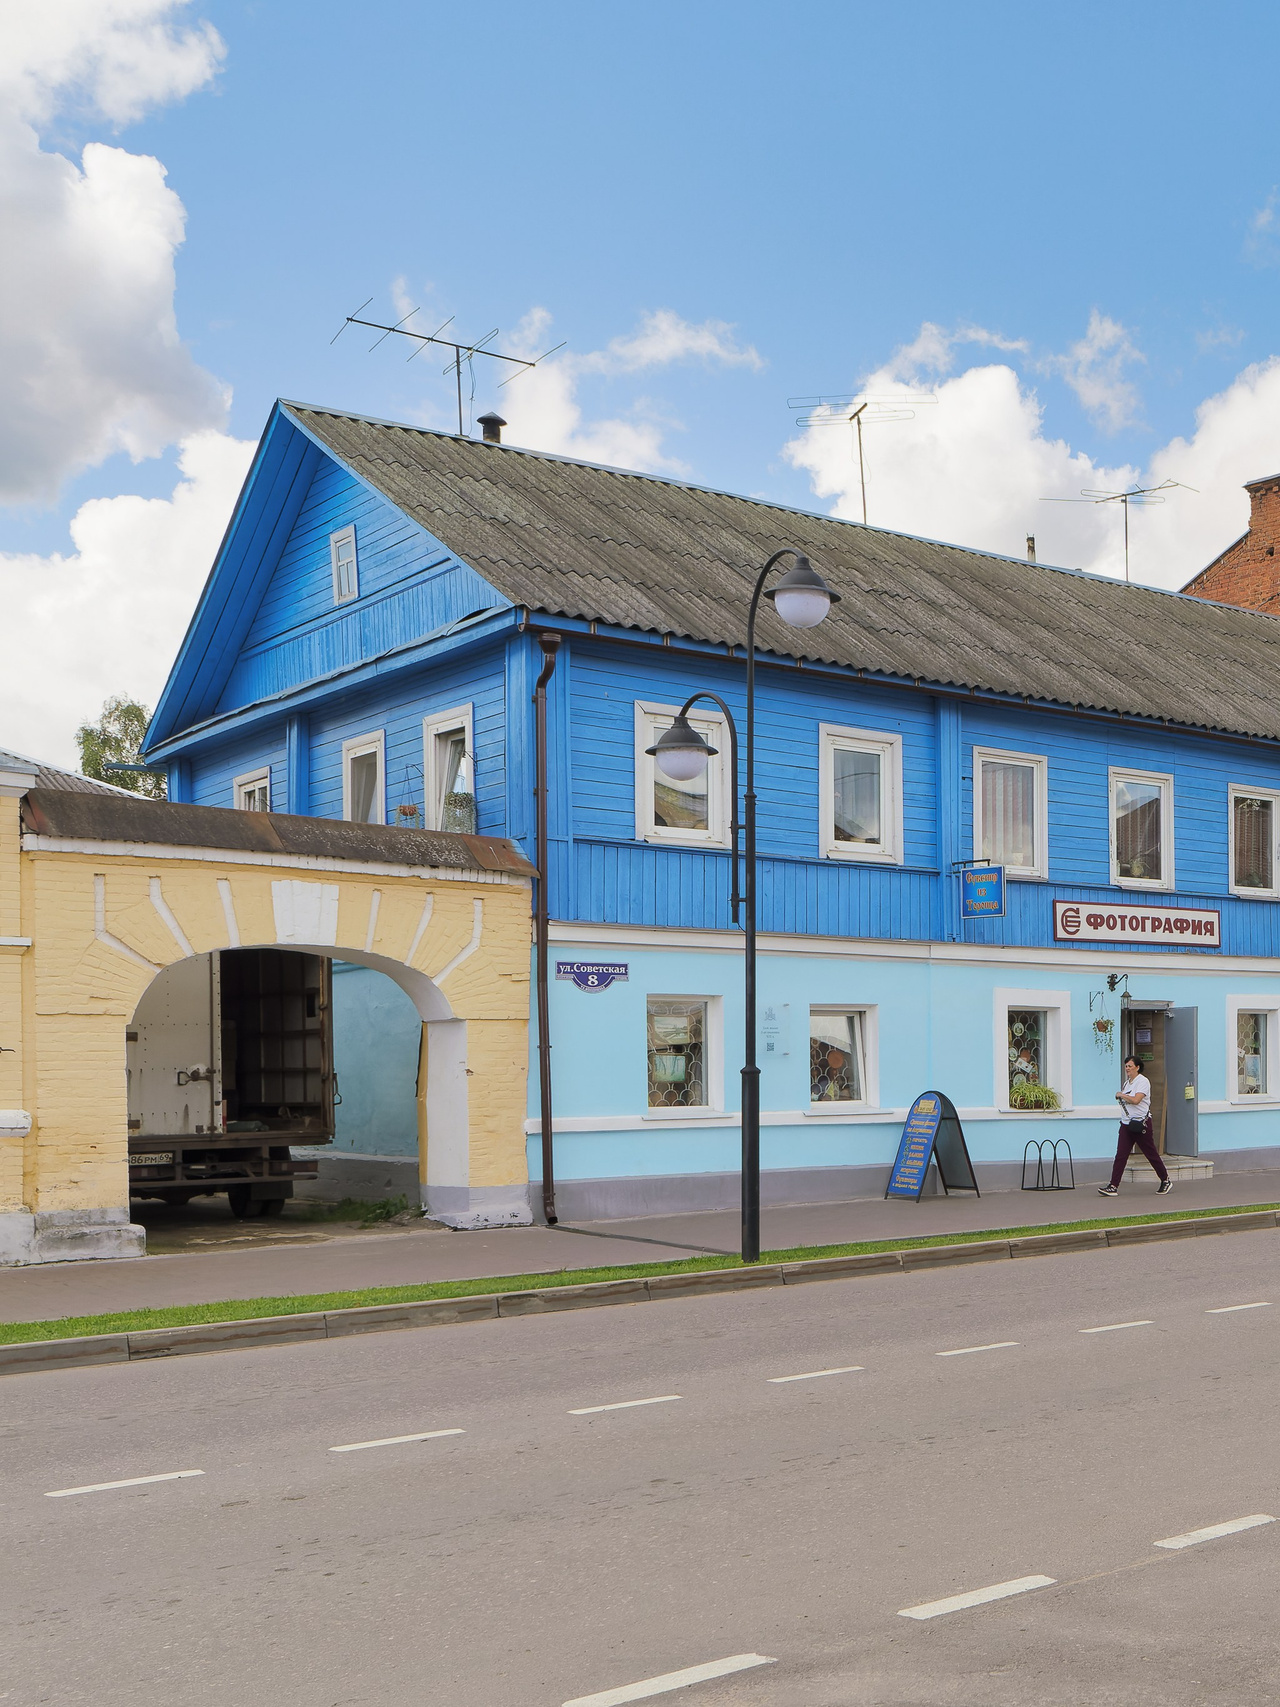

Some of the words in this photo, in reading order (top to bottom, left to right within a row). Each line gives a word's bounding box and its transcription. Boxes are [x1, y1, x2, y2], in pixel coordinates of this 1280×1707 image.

[977, 888, 987, 896] из
[1086, 913, 1215, 936] ФОТОГРАФИЯ
[587, 975, 598, 986] 8
[159, 1153, 170, 1161] 69
